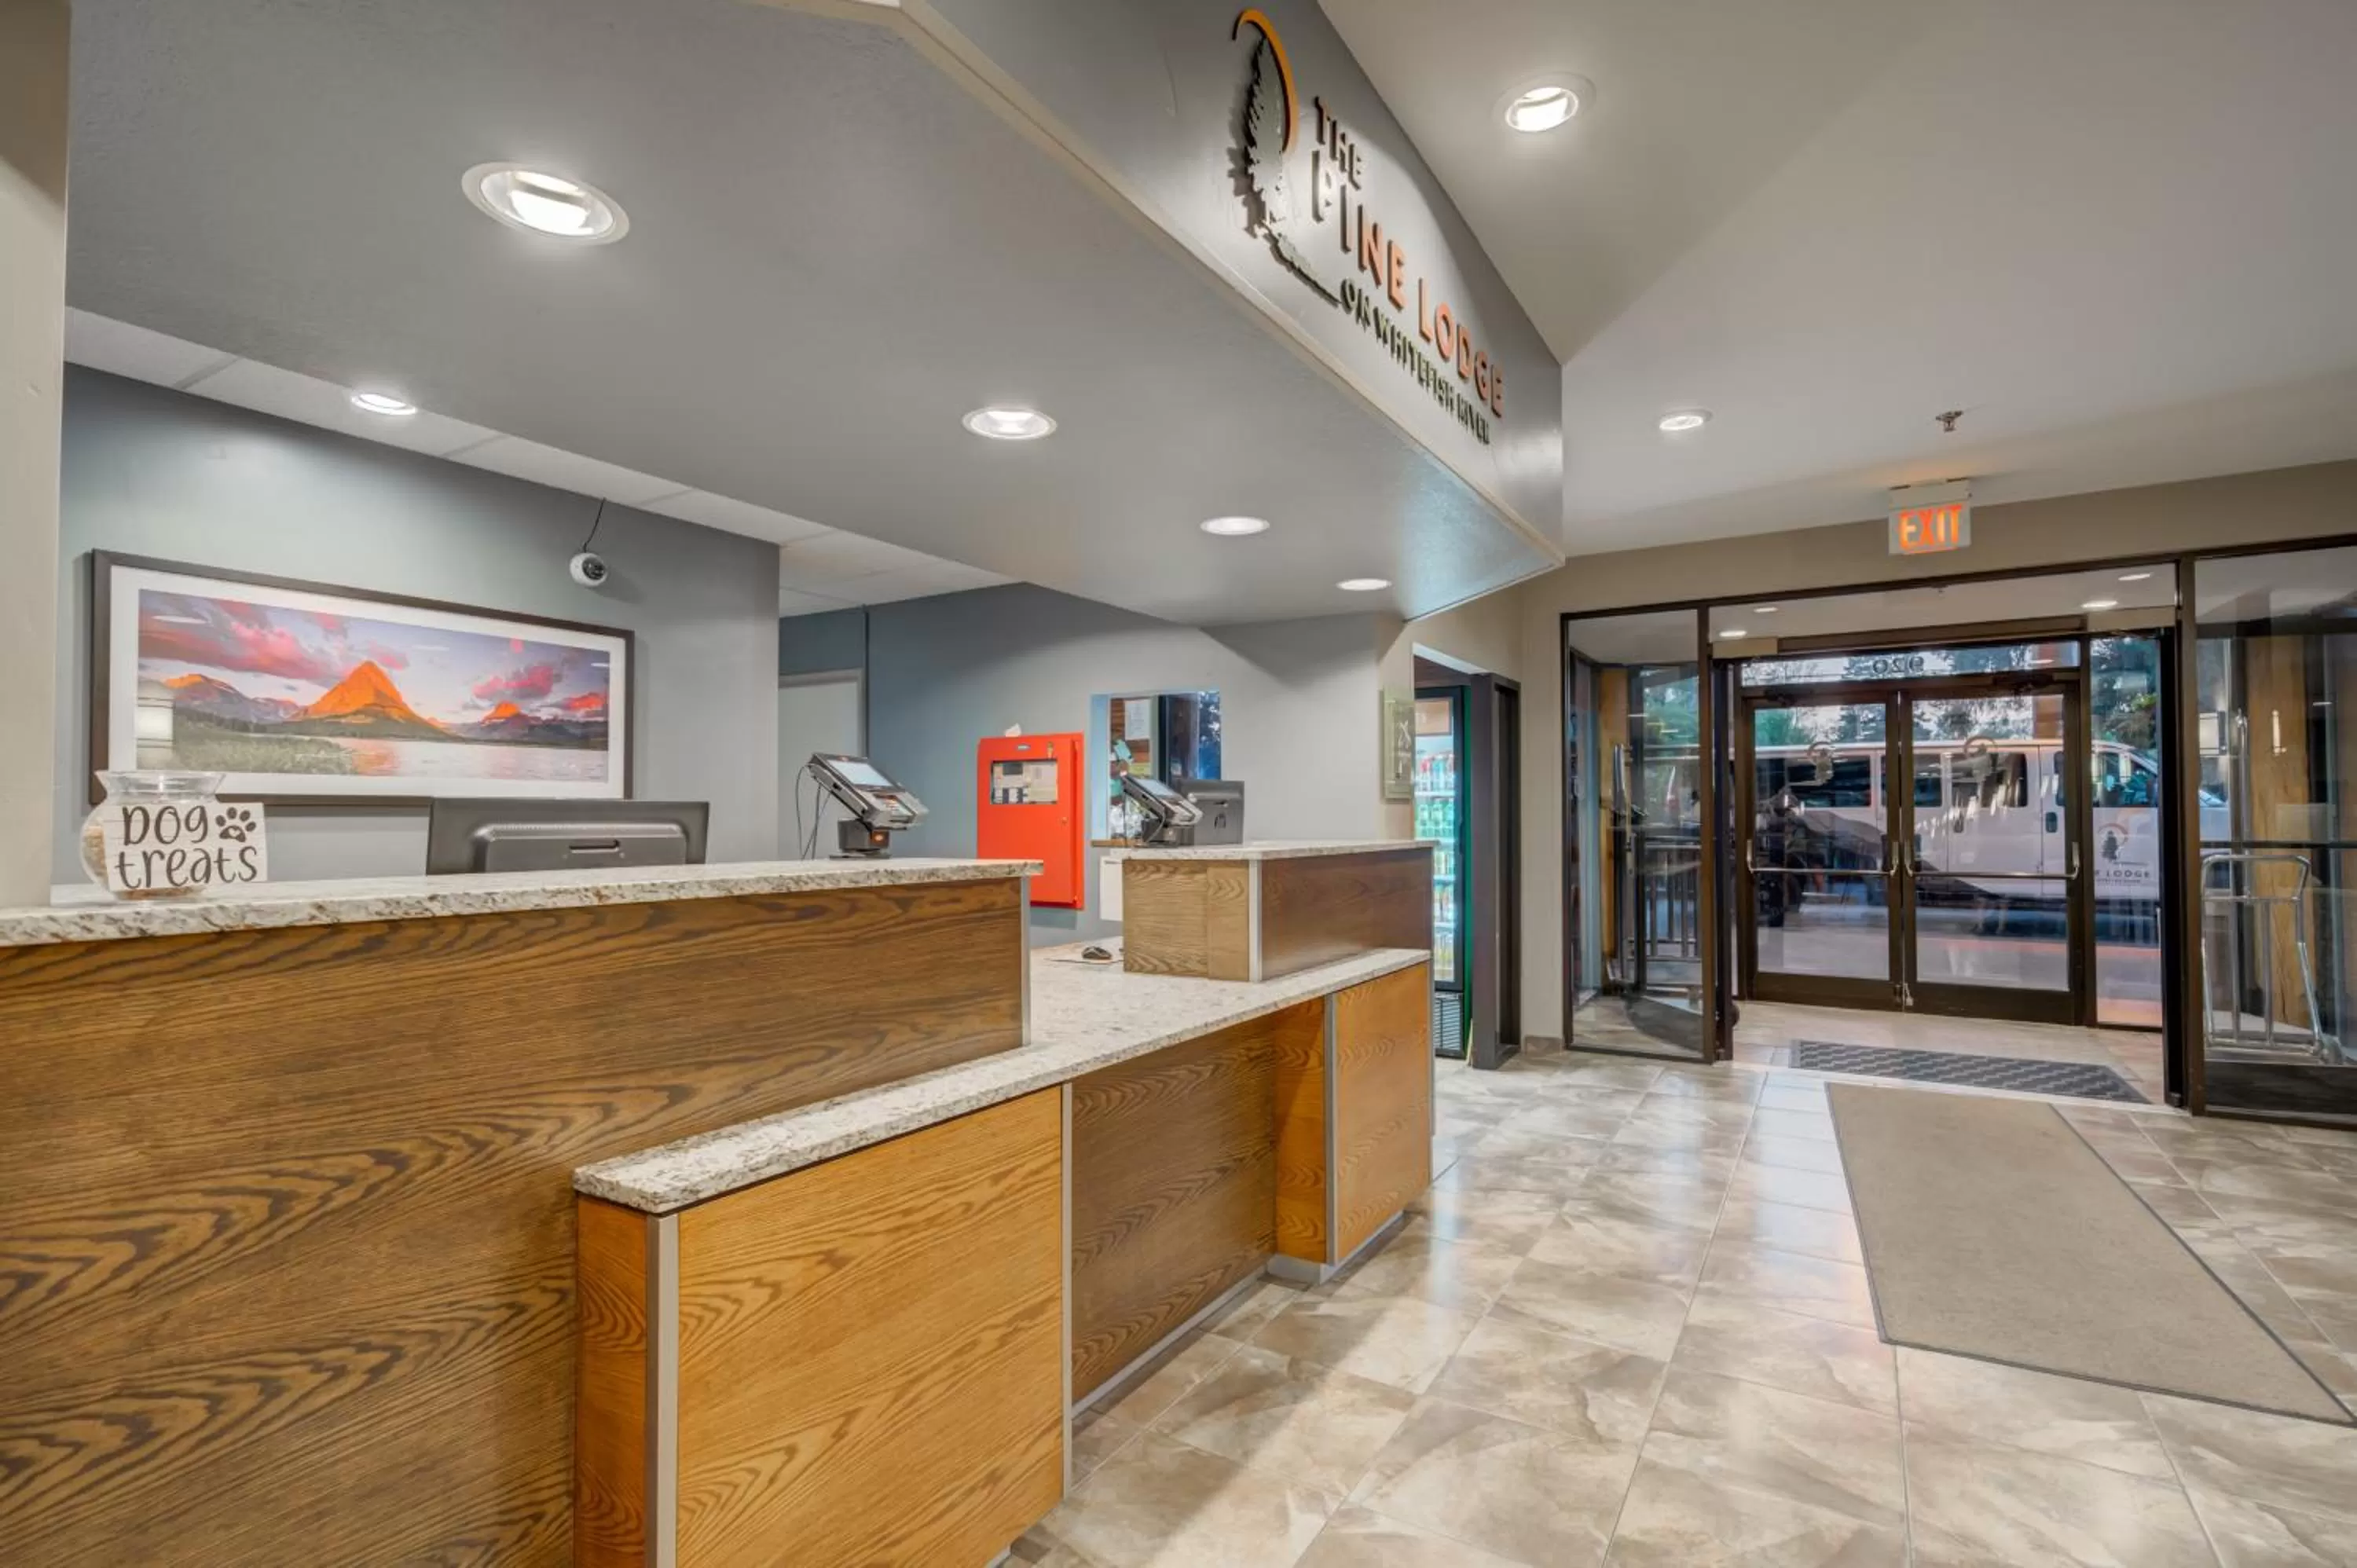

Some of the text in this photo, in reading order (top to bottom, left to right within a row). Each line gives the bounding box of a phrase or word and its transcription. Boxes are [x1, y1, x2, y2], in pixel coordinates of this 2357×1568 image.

[1314, 95, 1362, 190] THE
[1311, 149, 1505, 419] PINE LODGE
[1340, 277, 1372, 331] ON
[1373, 306, 1455, 416] WHITEFISH
[1898, 504, 1963, 549] EXIT
[115, 845, 258, 888] treats
